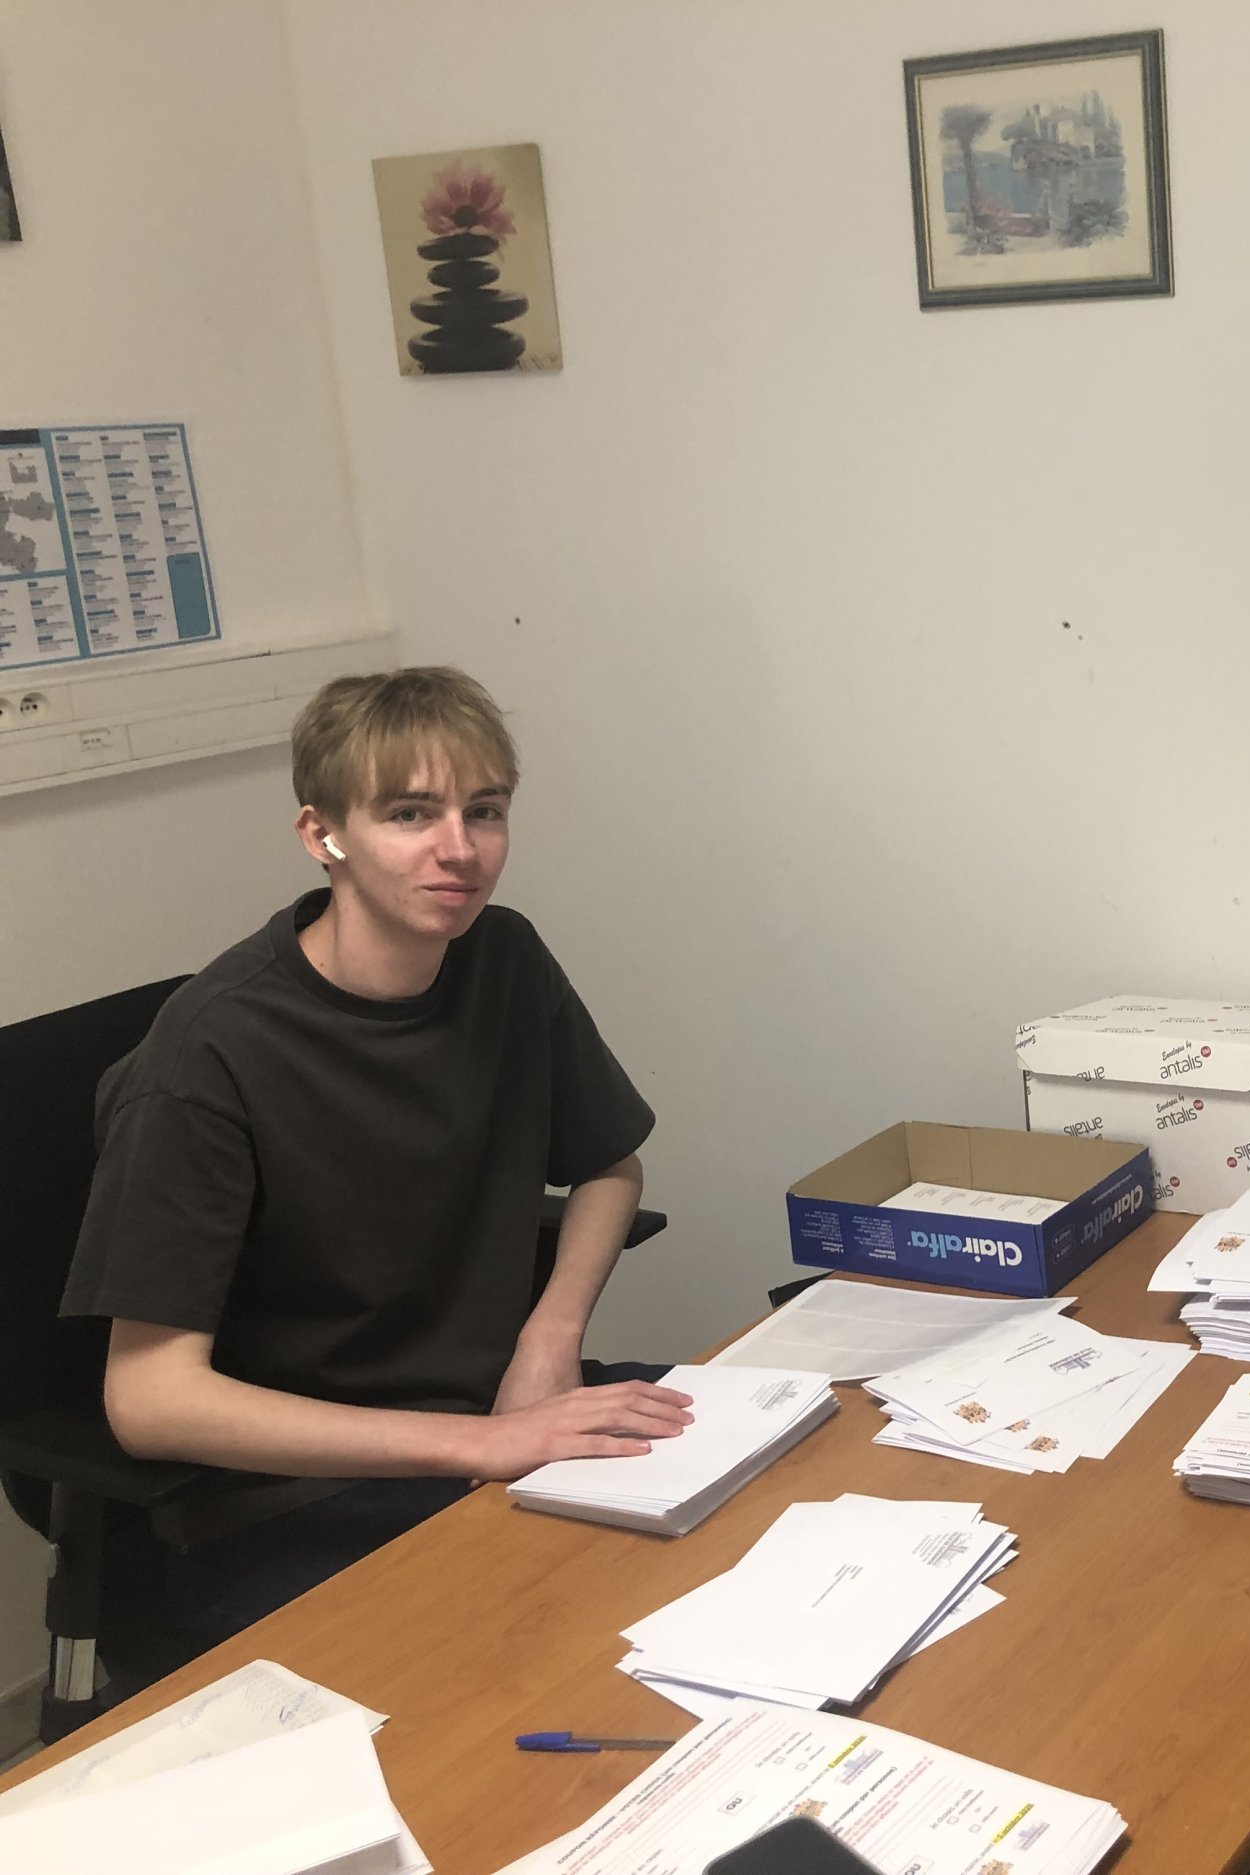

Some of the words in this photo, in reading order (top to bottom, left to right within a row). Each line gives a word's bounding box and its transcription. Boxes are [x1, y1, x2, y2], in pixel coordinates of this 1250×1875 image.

[1160, 1055, 1202, 1079] antalis
[1156, 1107, 1197, 1129] antalis
[1153, 1176, 1173, 1200] alis
[1081, 1184, 1144, 1244] Clairalfa
[911, 1230, 1022, 1267] Clairalfa
[726, 1796, 743, 1811] OU
